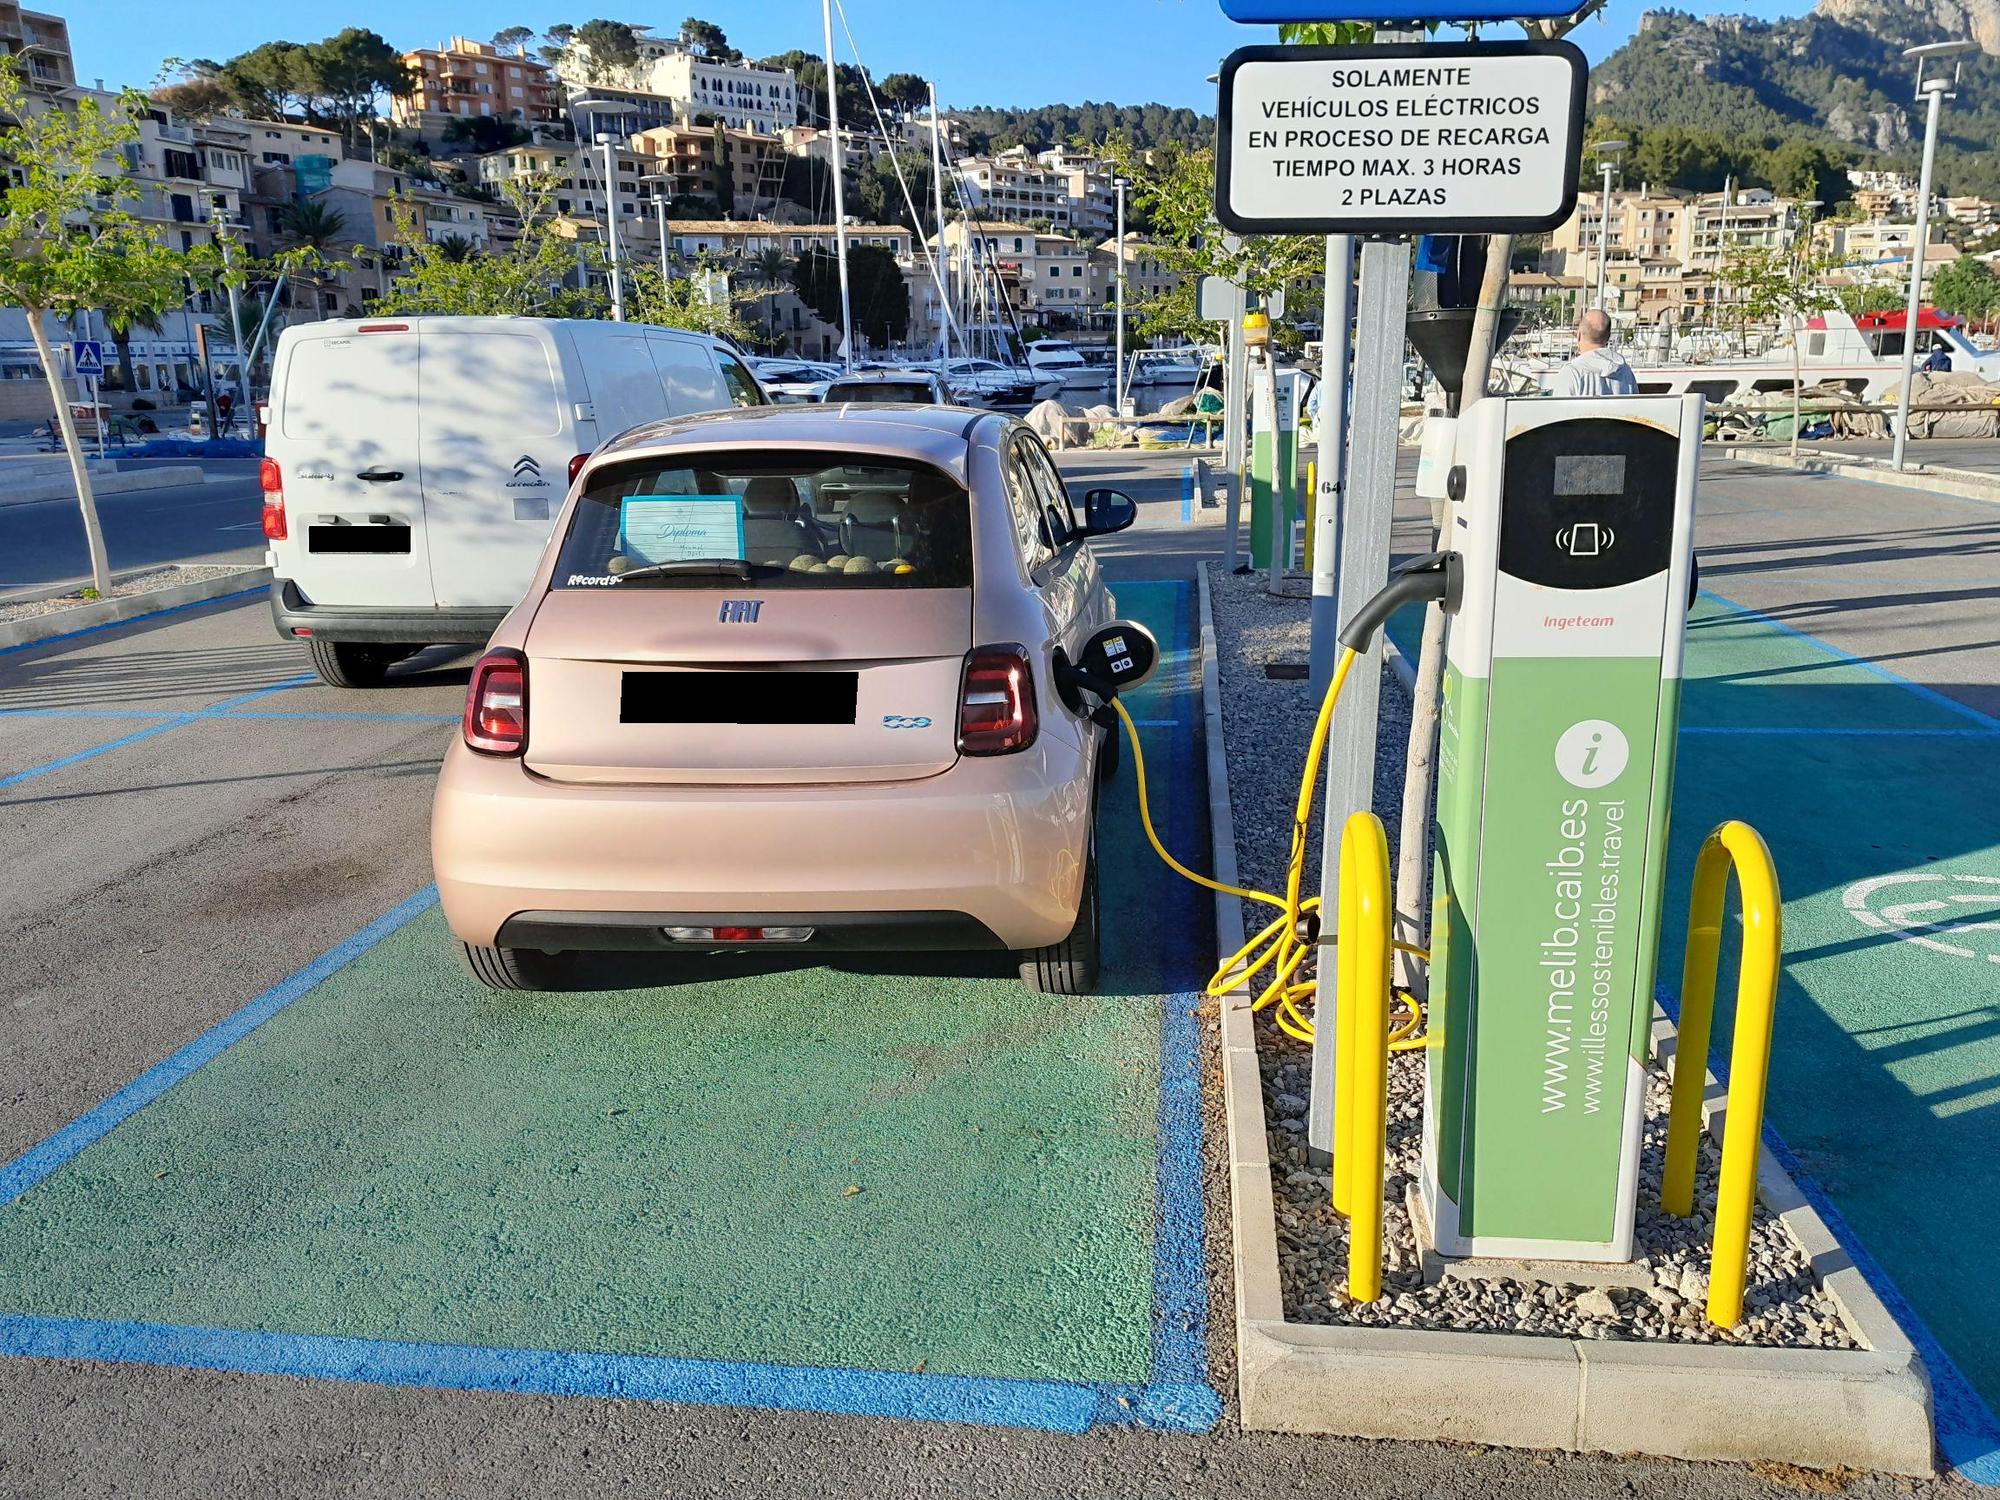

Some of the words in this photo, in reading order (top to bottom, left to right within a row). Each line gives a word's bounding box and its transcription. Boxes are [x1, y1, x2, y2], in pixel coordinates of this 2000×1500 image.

[1332, 68, 1471, 88] SOLAMENTE
[1261, 96, 1389, 118] VEHÍCULOS
[1396, 95, 1540, 117] ELÉCTRICOS
[1248, 131, 1278, 148] EN
[1285, 129, 1394, 148] PROCESO
[1400, 129, 1431, 147] DE
[1437, 127, 1550, 146] RECARGA
[1272, 159, 1355, 177] TIEMPO
[1362, 158, 1415, 177] MAX.
[1423, 158, 1435, 176] 3
[1442, 157, 1521, 176] HORAS
[1341, 188, 1353, 206] 2
[1360, 187, 1446, 206] PLAZAS
[656, 523, 707, 542] Diploma
[719, 600, 764, 623] FIAT
[1543, 615, 1615, 630] Ingeteam
[1540, 799, 1588, 1115] www.melib.caib.es
[1581, 799, 1625, 1115] www.illessostenibles.travel
